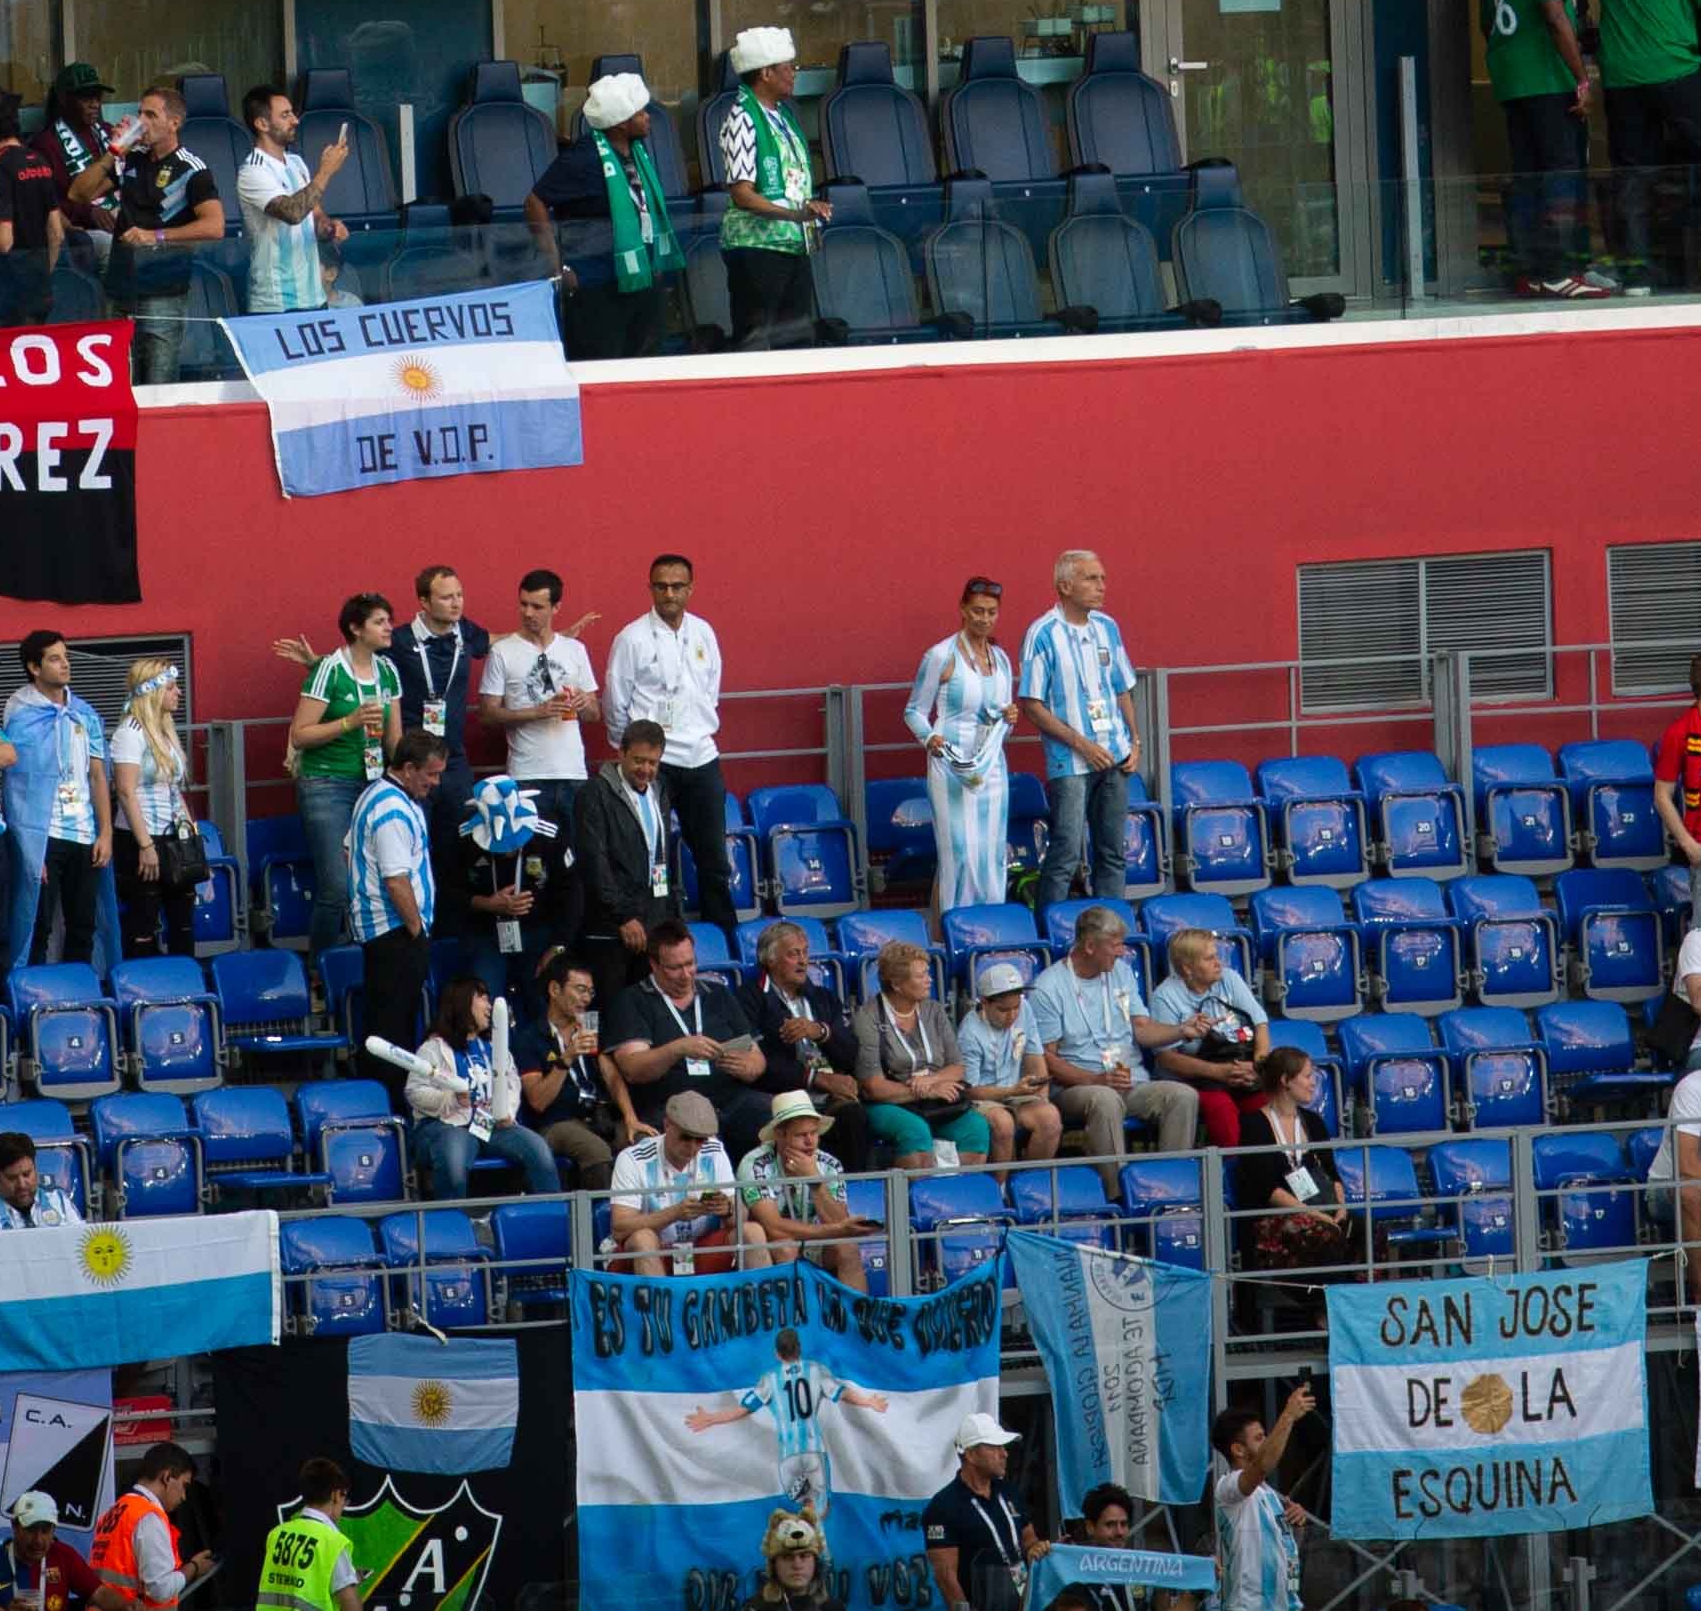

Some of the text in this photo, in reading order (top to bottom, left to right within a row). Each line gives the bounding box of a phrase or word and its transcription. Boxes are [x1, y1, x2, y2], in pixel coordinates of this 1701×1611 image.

[274, 300, 515, 363] LOS CUERVOS
[356, 432, 397, 475] DE
[592, 1281, 624, 1359] ES
[634, 1282, 675, 1358] TU
[683, 1275, 810, 1353] GAMBETA
[1380, 1282, 1598, 1348] SAN JOSE
[784, 1375, 814, 1420] 10
[1406, 1367, 1578, 1429] DE LA
[1392, 1456, 1578, 1521] ESQUINA
[273, 1530, 319, 1570] 5875
[402, 1539, 448, 1594] A
[1078, 1549, 1185, 1579] ARGENTINA
